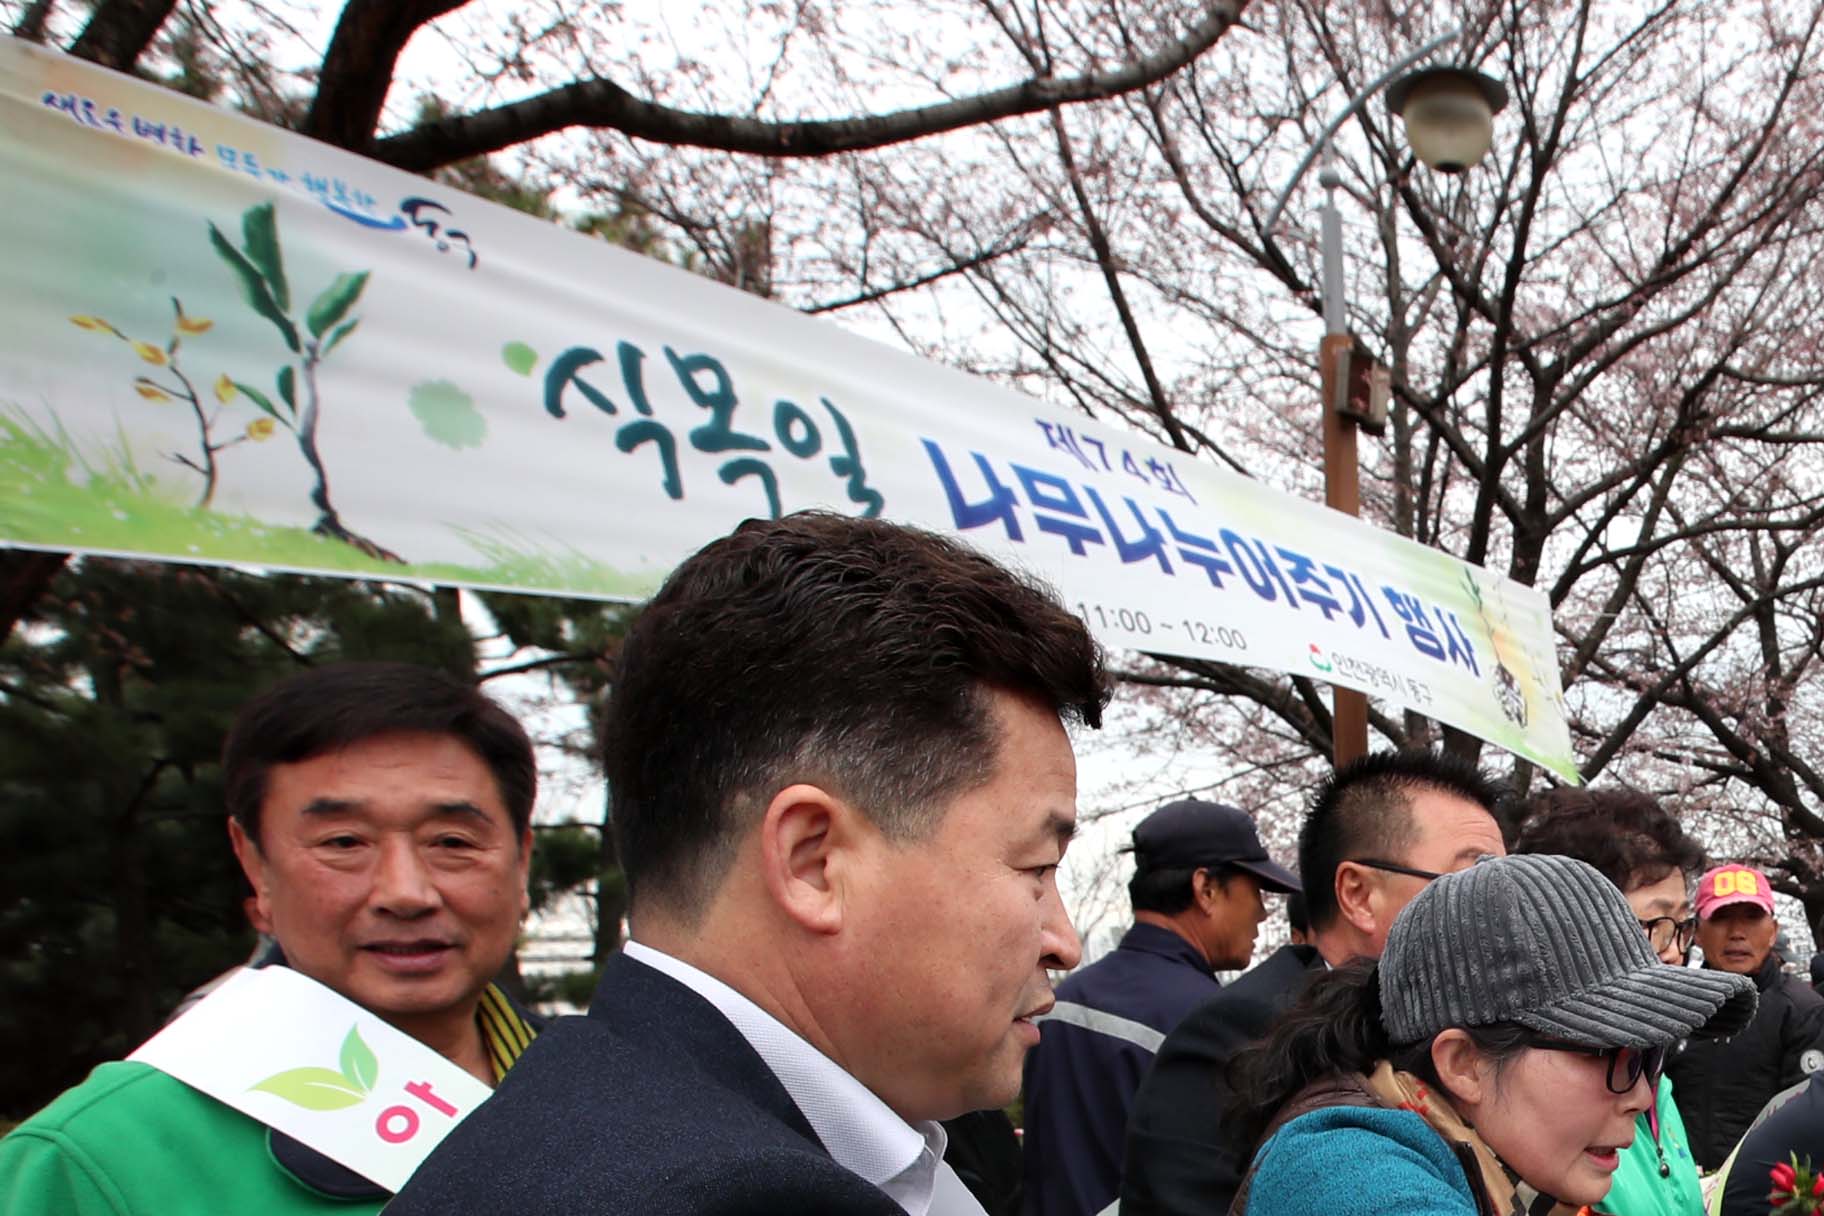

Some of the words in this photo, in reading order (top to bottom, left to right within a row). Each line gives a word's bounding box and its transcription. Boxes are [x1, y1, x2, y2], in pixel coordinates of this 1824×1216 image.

[545, 341, 884, 520] 식목일
[1035, 417, 1196, 505] 제74회
[921, 438, 1389, 641] 나무나누어주기
[1381, 585, 1480, 678] 행사
[1182, 618, 1248, 651] 12:00
[1331, 651, 1408, 697] 인천광역시
